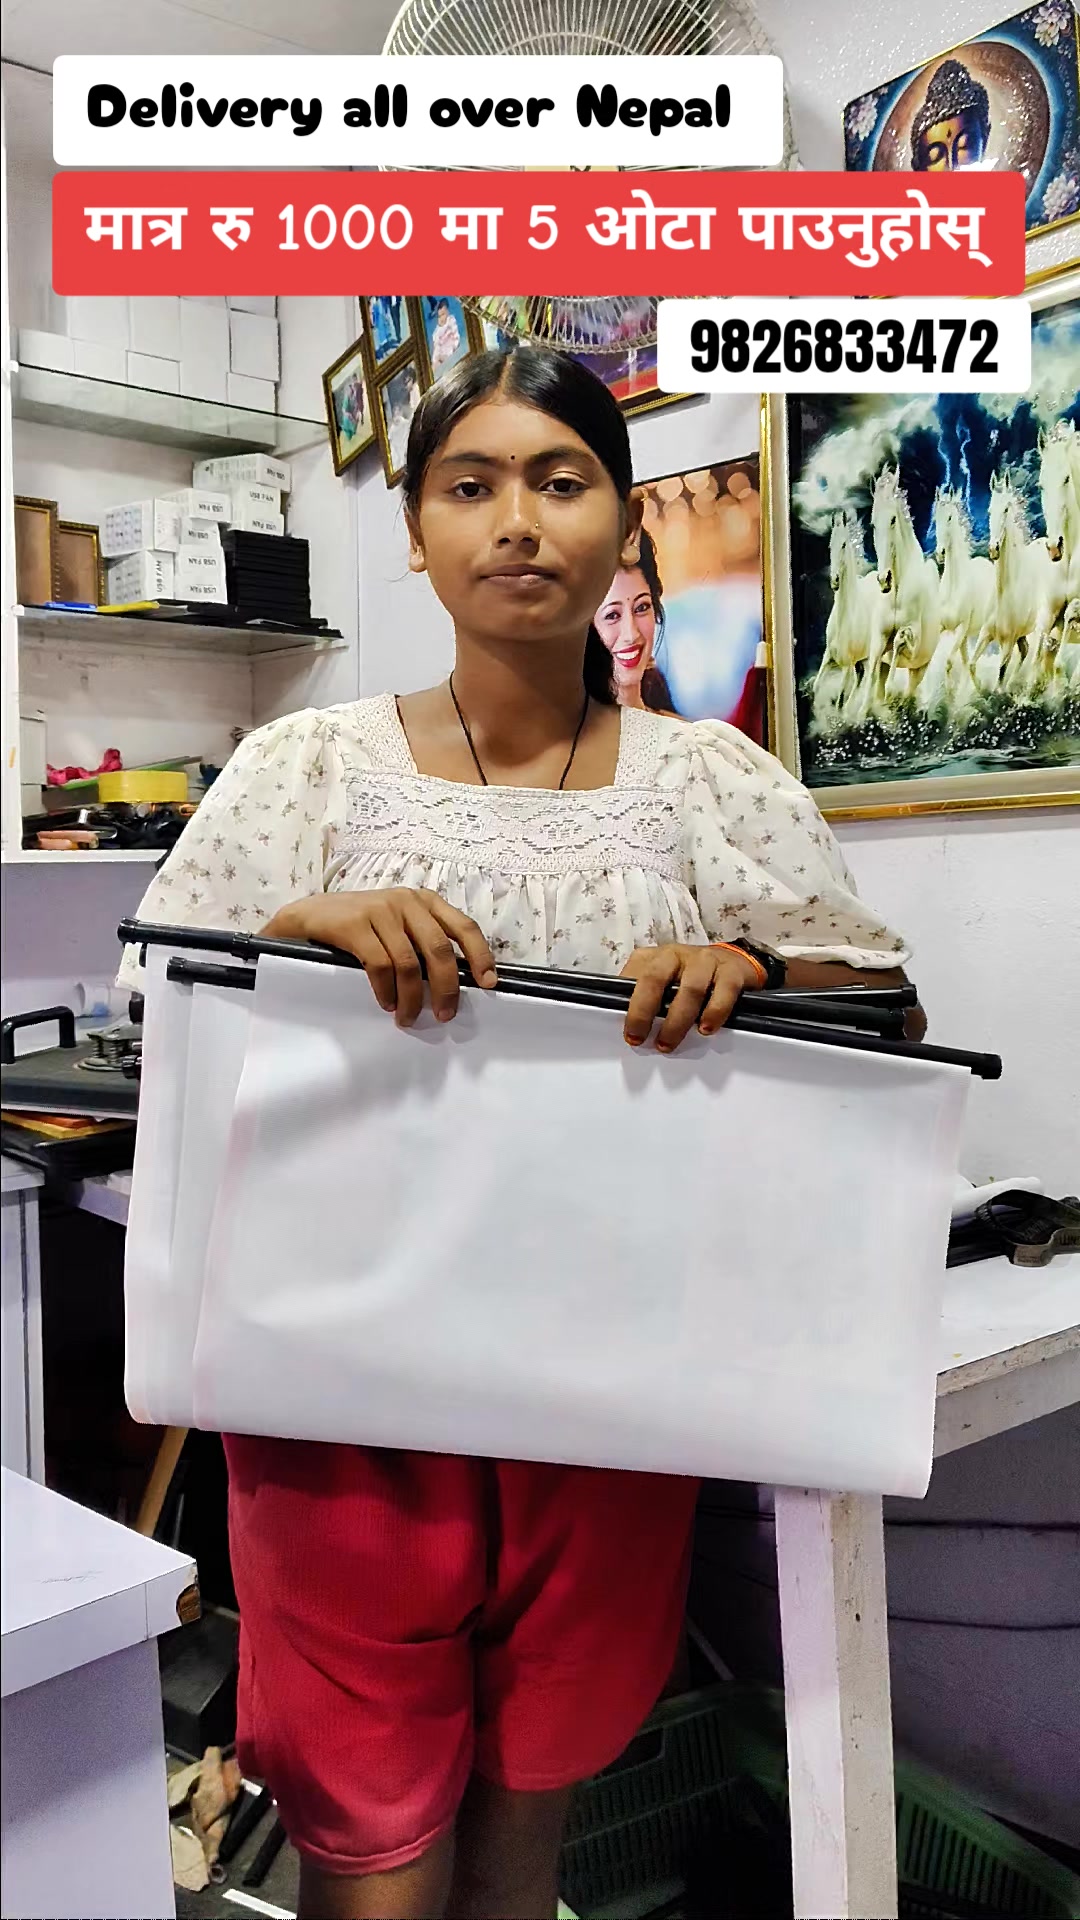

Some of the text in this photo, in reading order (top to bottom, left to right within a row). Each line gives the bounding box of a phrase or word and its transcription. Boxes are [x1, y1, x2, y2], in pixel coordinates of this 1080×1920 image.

[249, 491, 274, 502] USB FAN
[199, 504, 223, 513] USB FAN
